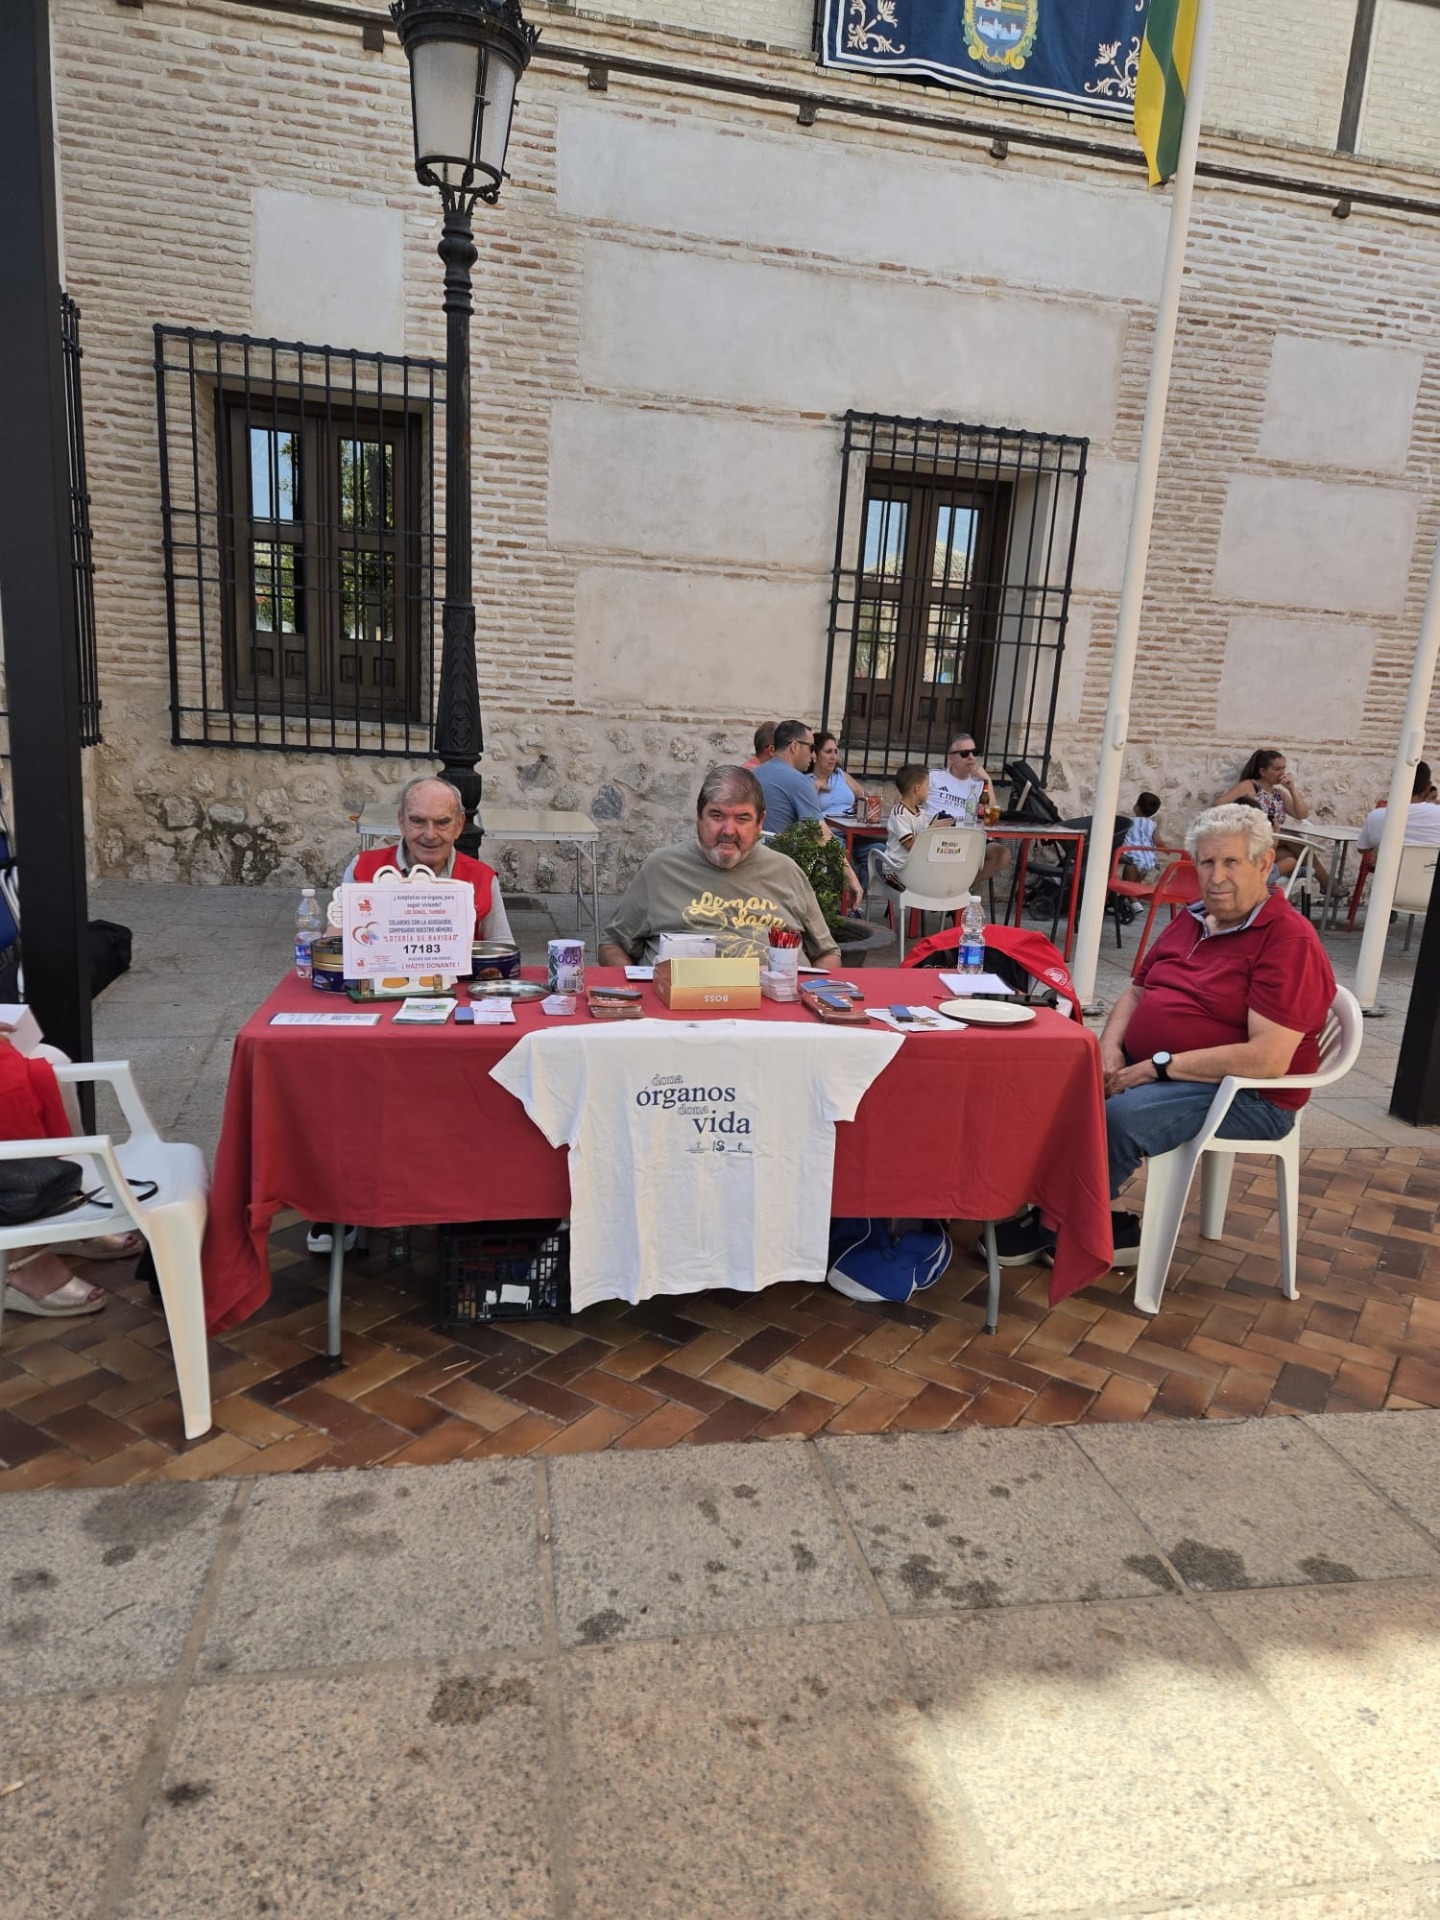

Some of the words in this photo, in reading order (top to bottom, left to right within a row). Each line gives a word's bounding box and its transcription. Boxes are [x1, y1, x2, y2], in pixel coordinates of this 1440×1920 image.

[689, 891, 778, 917] Lemon
[403, 944, 441, 954] 17183
[703, 994, 729, 1003] BOSS
[651, 1073, 685, 1087] dona
[636, 1086, 736, 1110] órganos
[677, 1102, 709, 1116] dona
[692, 1109, 752, 1135] vida
